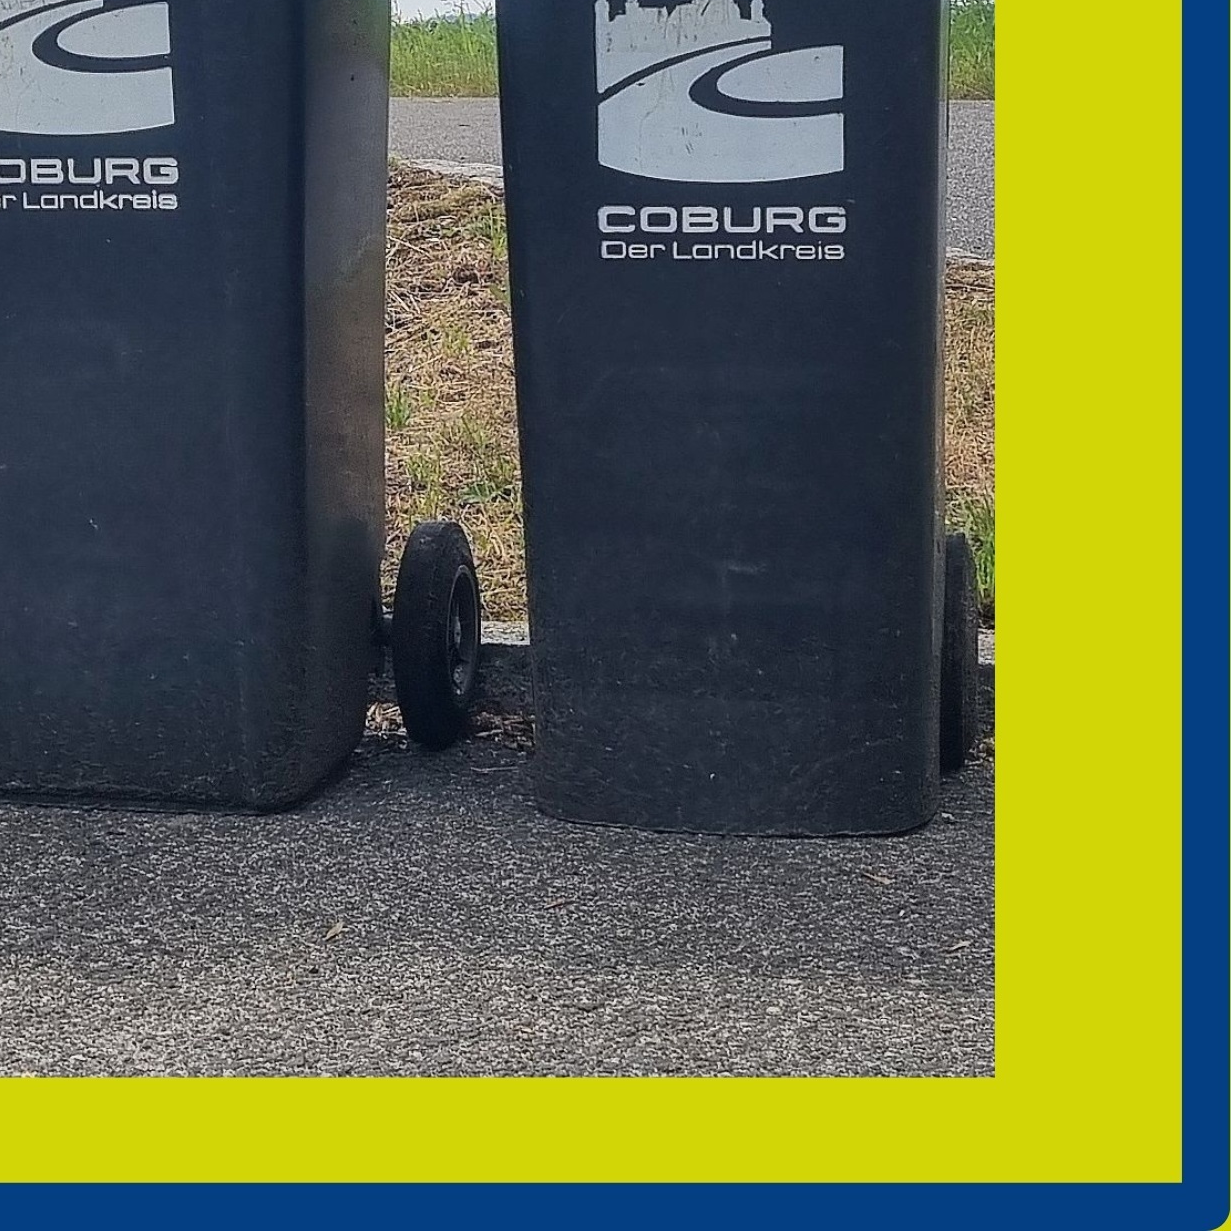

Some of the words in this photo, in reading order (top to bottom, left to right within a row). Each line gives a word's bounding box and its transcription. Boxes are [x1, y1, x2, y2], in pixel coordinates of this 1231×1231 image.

[23, 189, 178, 210] Landkreis
[597, 206, 847, 233] COBURG
[601, 240, 665, 259] Der
[673, 240, 845, 260] Landkreis
